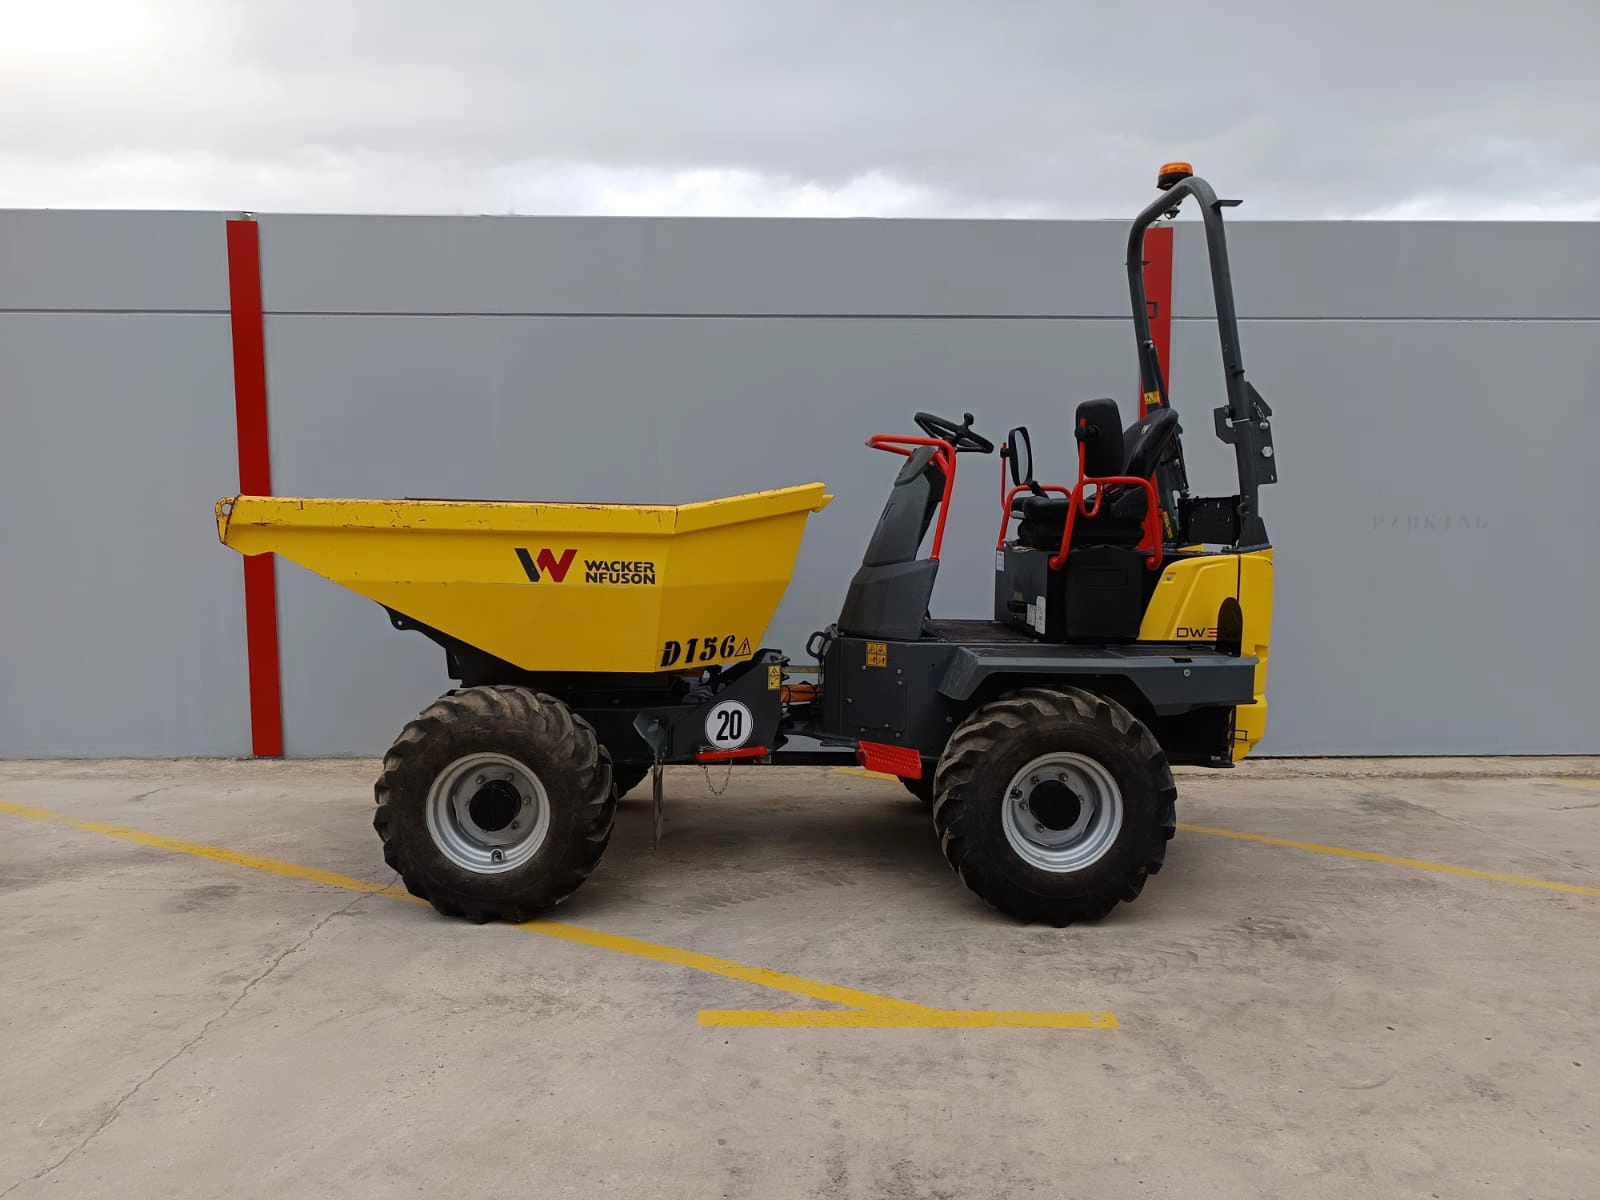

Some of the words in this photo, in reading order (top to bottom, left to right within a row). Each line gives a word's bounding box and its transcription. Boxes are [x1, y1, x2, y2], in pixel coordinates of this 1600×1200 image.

[584, 560, 656, 573] WACKER
[660, 635, 736, 667] D156
[716, 709, 742, 741] 20
